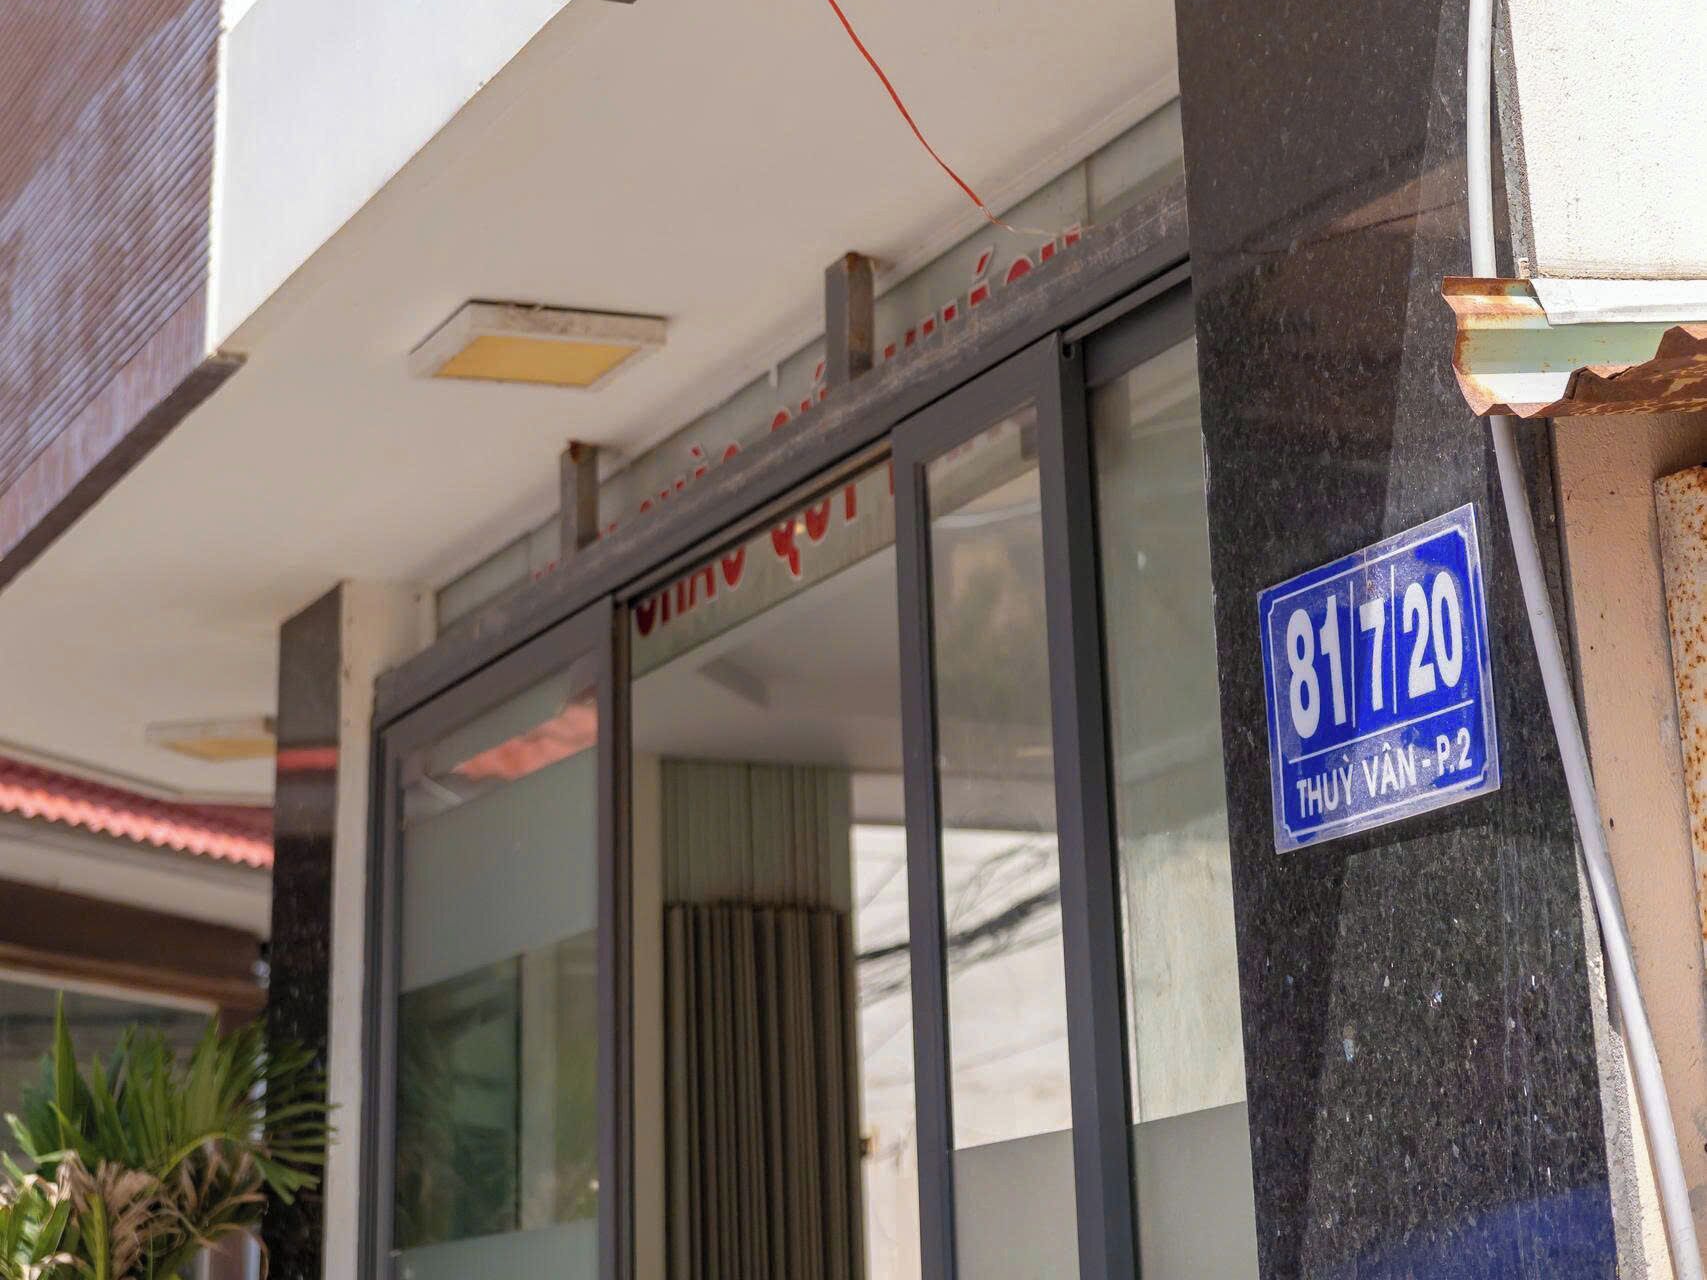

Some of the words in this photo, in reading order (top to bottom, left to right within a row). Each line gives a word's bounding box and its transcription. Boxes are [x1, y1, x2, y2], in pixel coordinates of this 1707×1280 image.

[1297, 758, 1353, 818] THUỲ
[1362, 743, 1417, 799] VÂN
[1436, 727, 1472, 777] P.2
